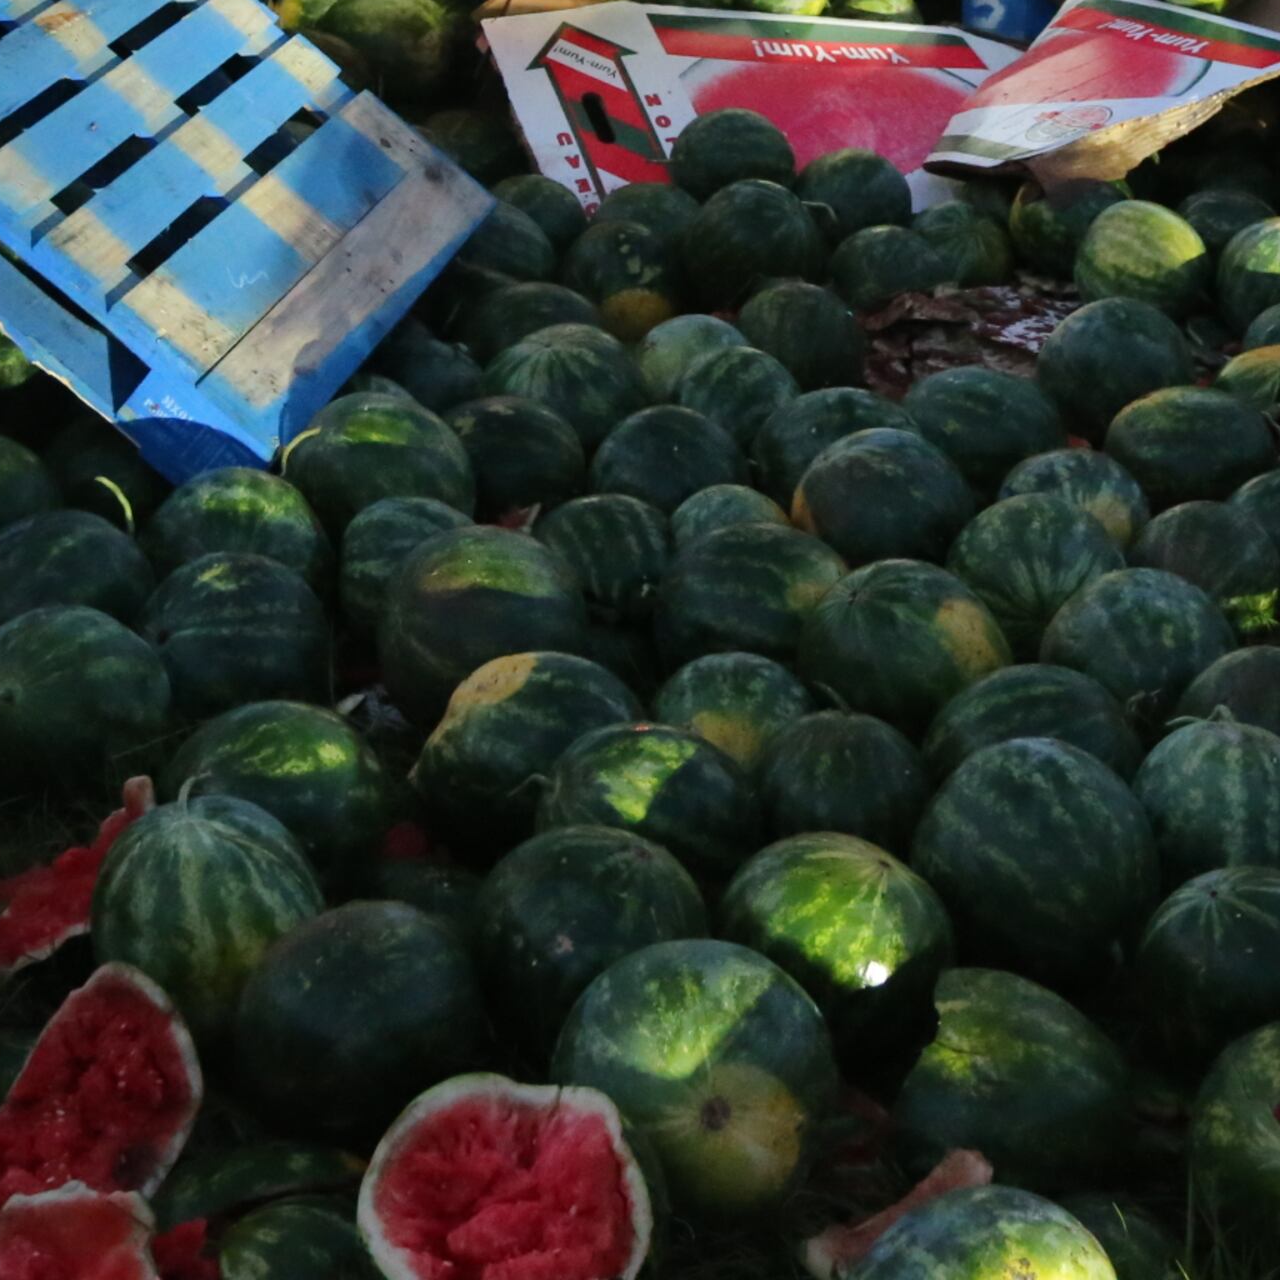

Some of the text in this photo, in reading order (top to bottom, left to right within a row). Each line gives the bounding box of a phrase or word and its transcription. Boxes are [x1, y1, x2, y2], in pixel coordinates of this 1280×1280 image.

[751, 39, 911, 65] Yum-Yum!
[1096, 17, 1211, 55] Yum-Yum!
[552, 46, 618, 79] Yum-Yum!
